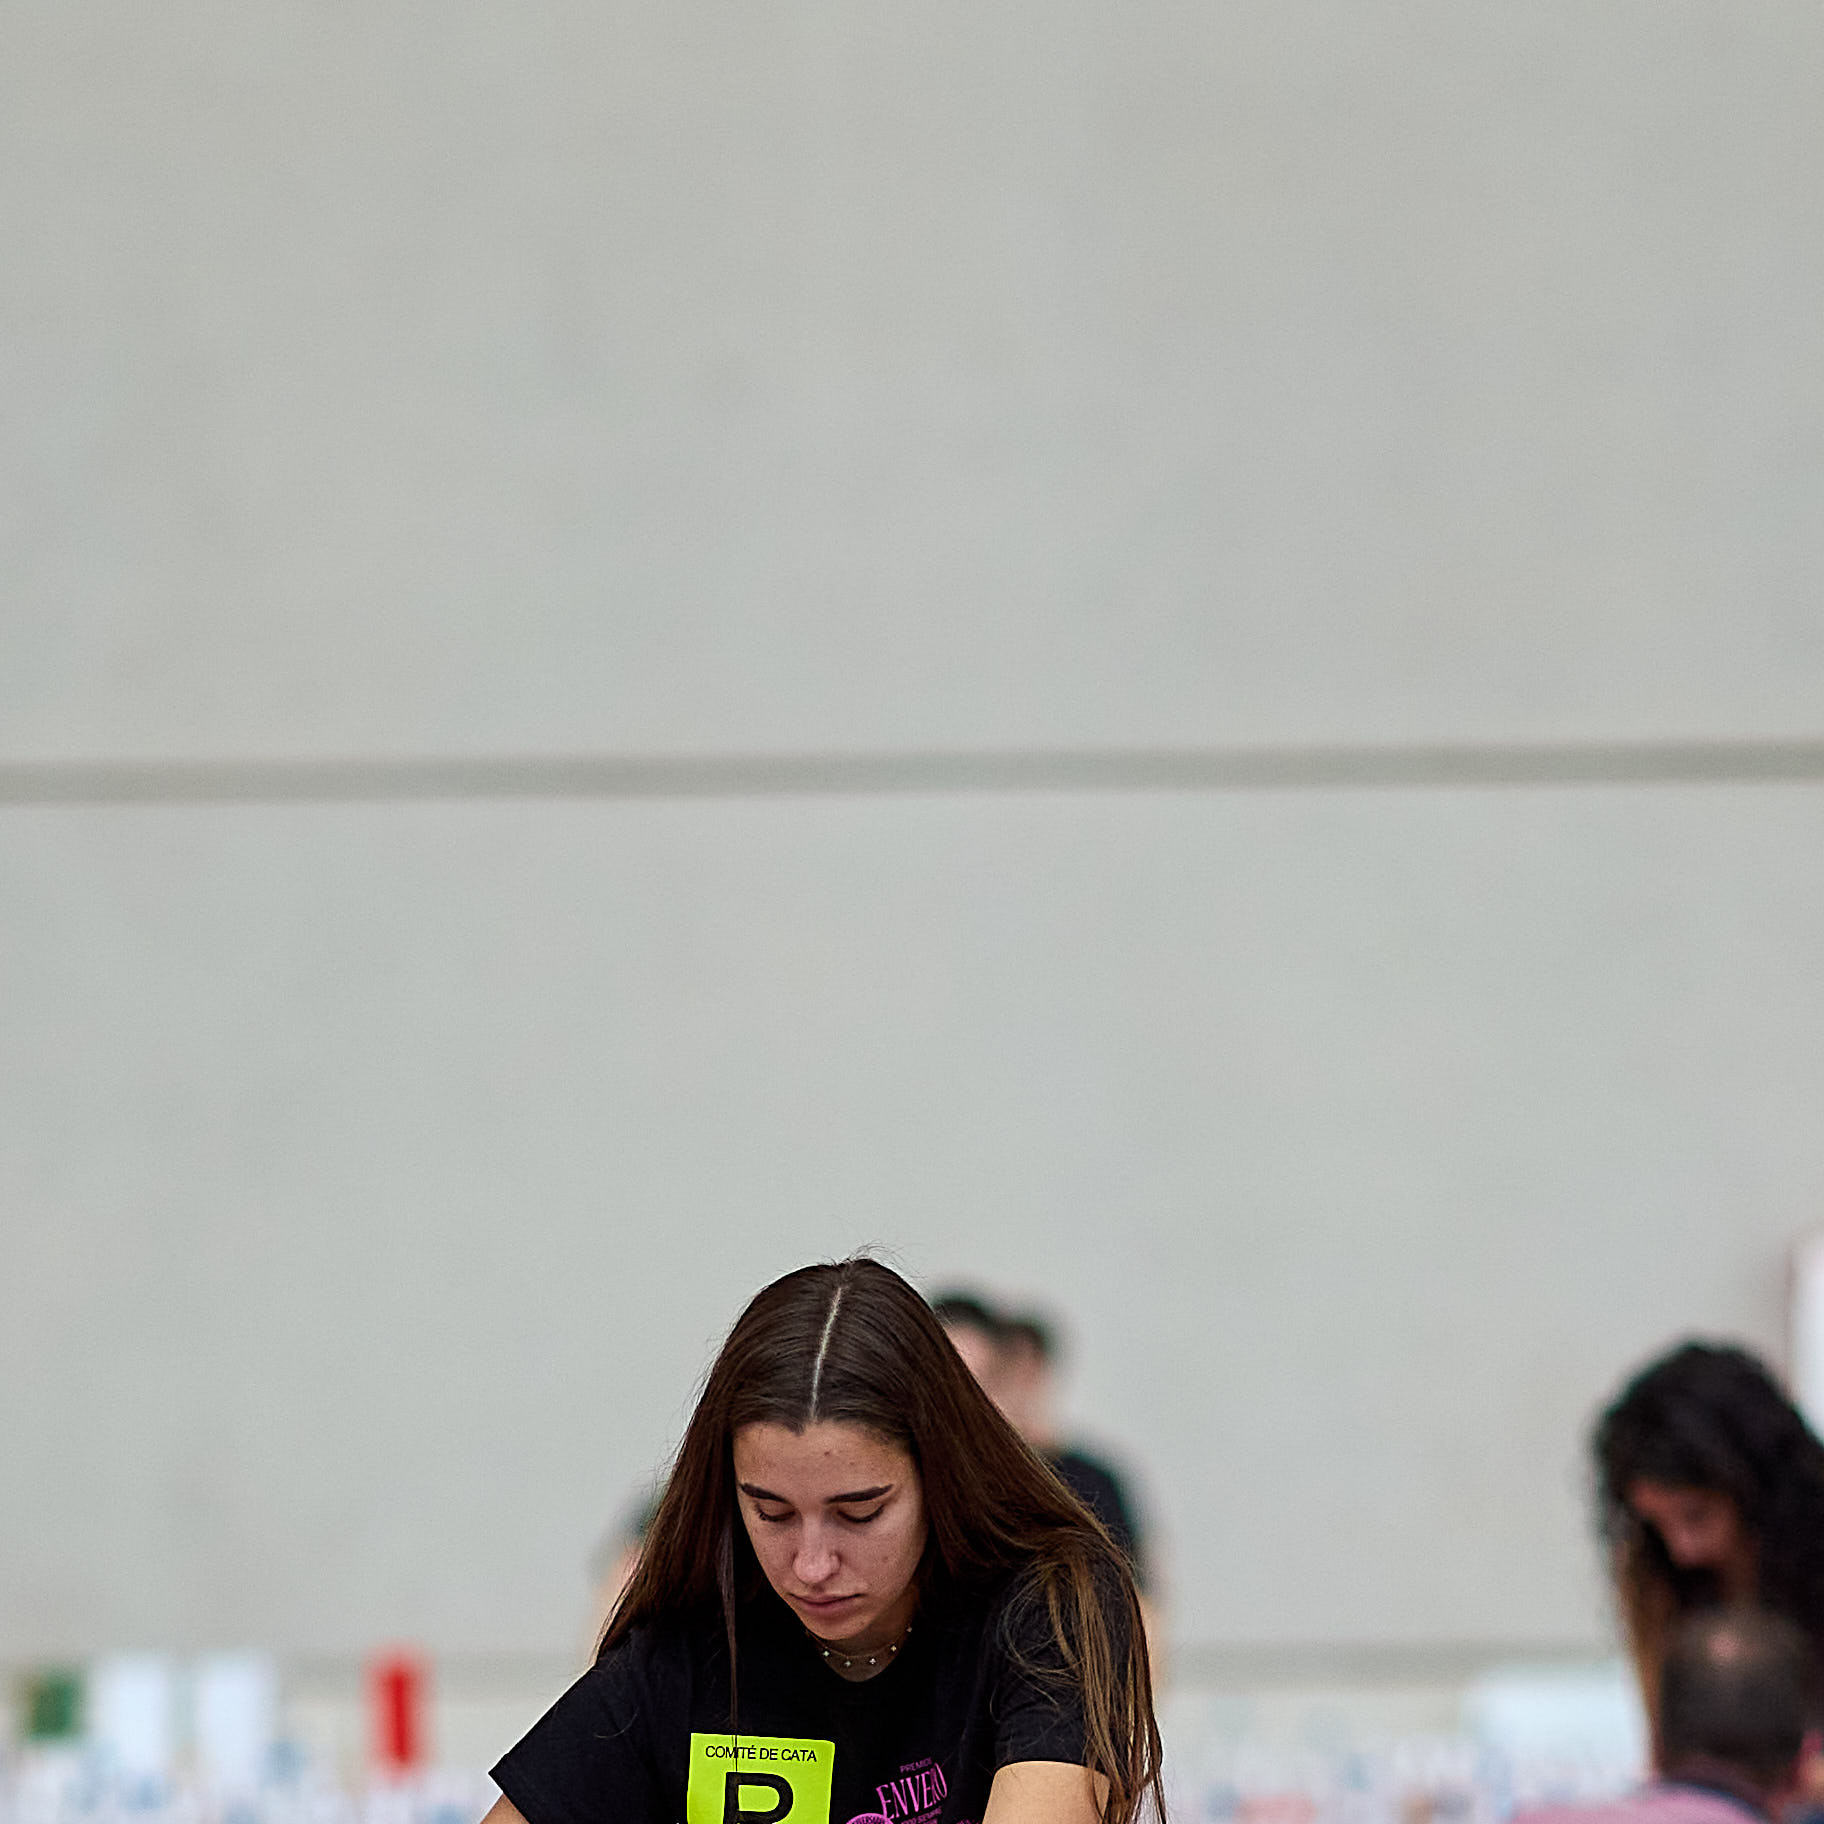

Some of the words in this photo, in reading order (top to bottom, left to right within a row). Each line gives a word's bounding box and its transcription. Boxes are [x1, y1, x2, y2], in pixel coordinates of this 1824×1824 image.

[705, 1744, 757, 1760] COMITÉ
[759, 1747, 778, 1761] DE
[781, 1748, 817, 1762] CATA
[876, 1762, 948, 1820] ENVERO
